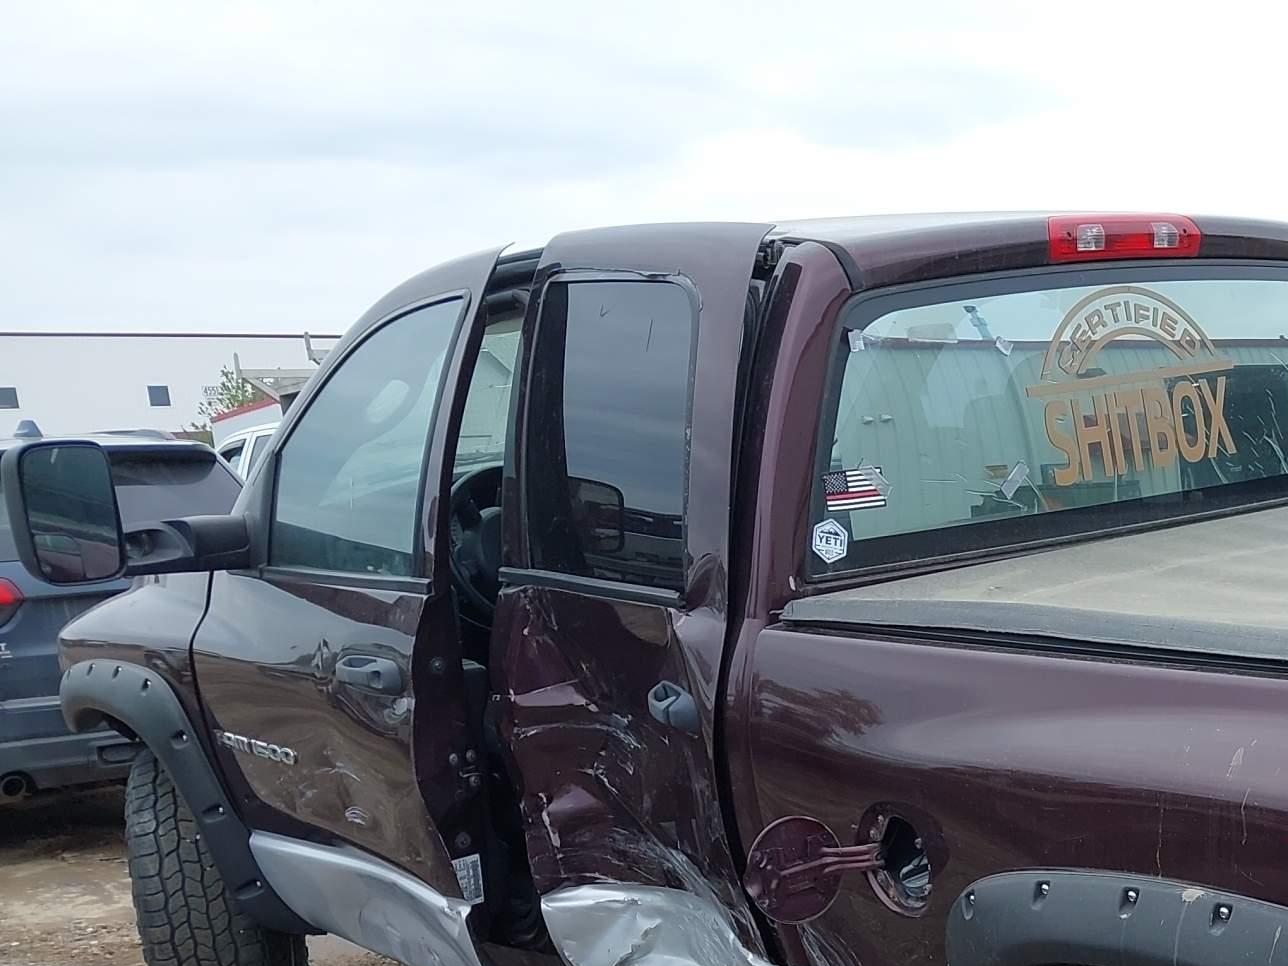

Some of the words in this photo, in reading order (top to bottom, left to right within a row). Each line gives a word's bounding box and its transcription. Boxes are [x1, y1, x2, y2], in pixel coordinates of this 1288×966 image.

[1058, 300, 1200, 375] CERTIFIED
[1044, 375, 1237, 486] SHITBOX
[817, 534, 843, 548] YETI
